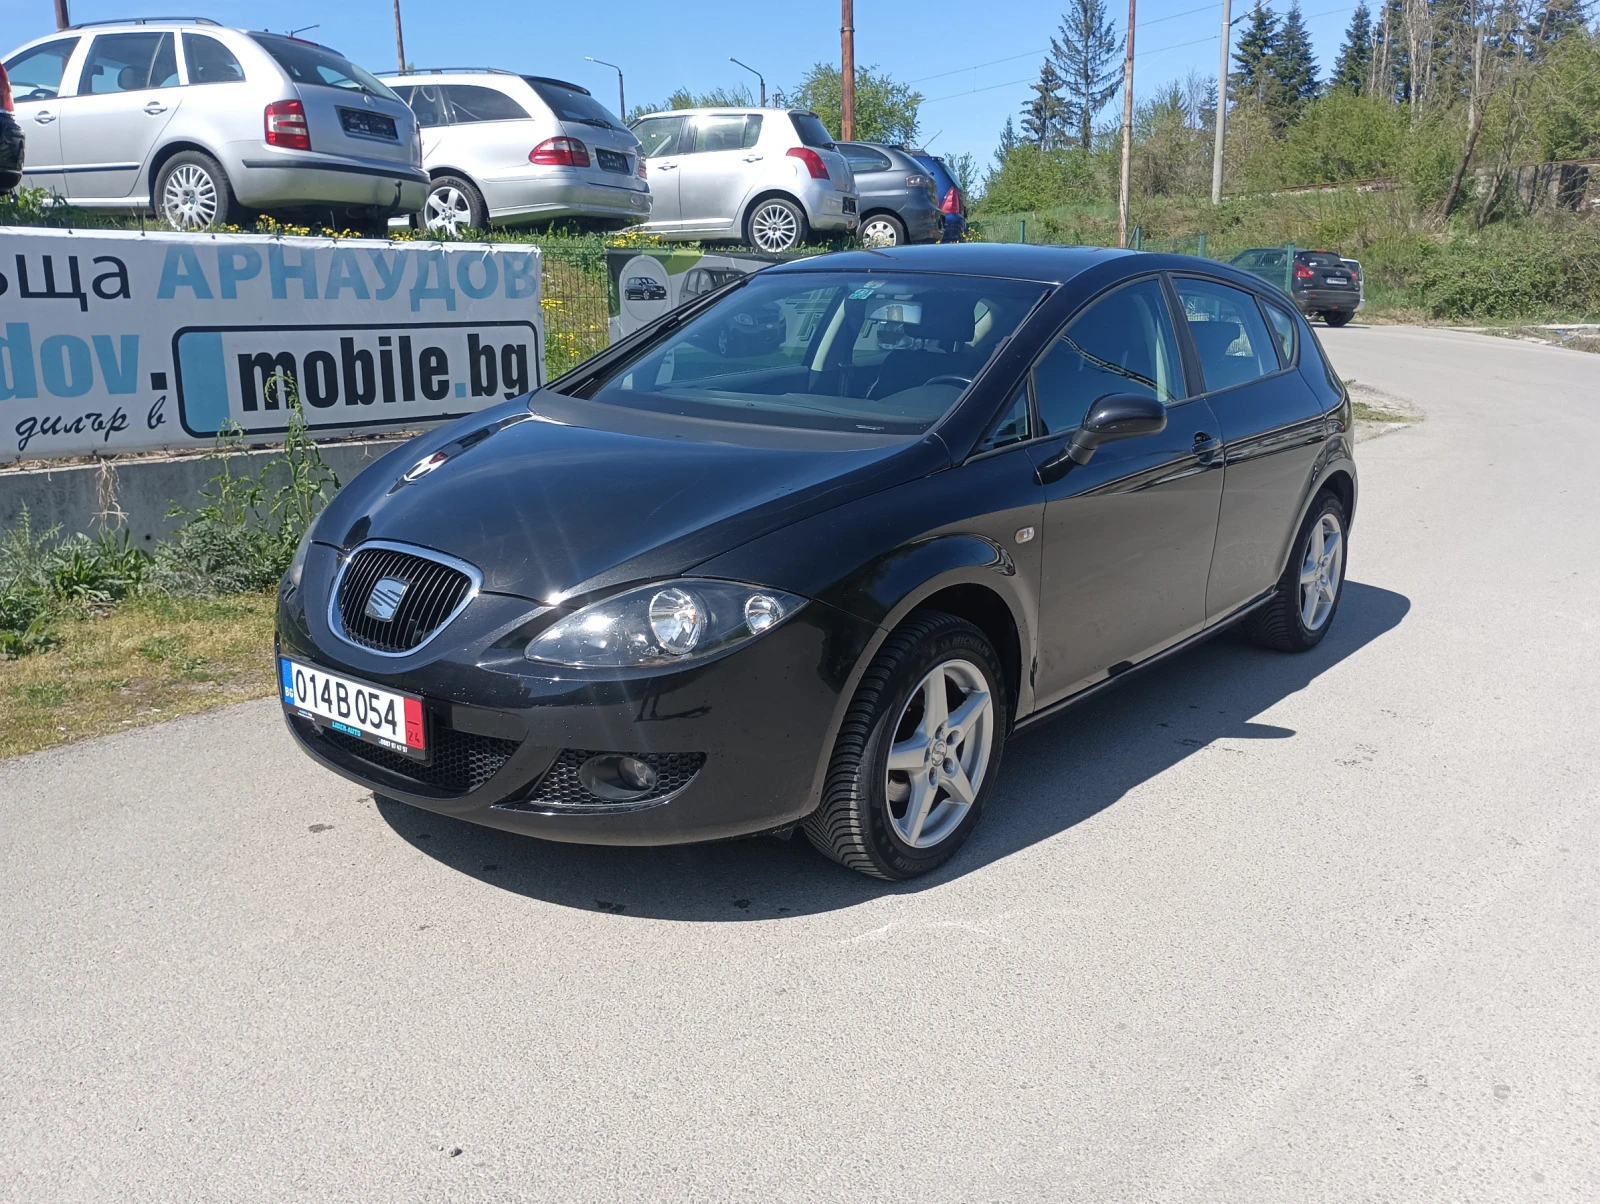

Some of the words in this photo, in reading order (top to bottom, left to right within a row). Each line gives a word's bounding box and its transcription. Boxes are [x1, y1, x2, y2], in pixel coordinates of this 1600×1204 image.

[0, 254, 132, 313] ща
[156, 243, 538, 312] АРНАУДОВ
[237, 333, 529, 412] mobile.bg
[15, 406, 130, 451] дилър
[147, 395, 167, 430] в
